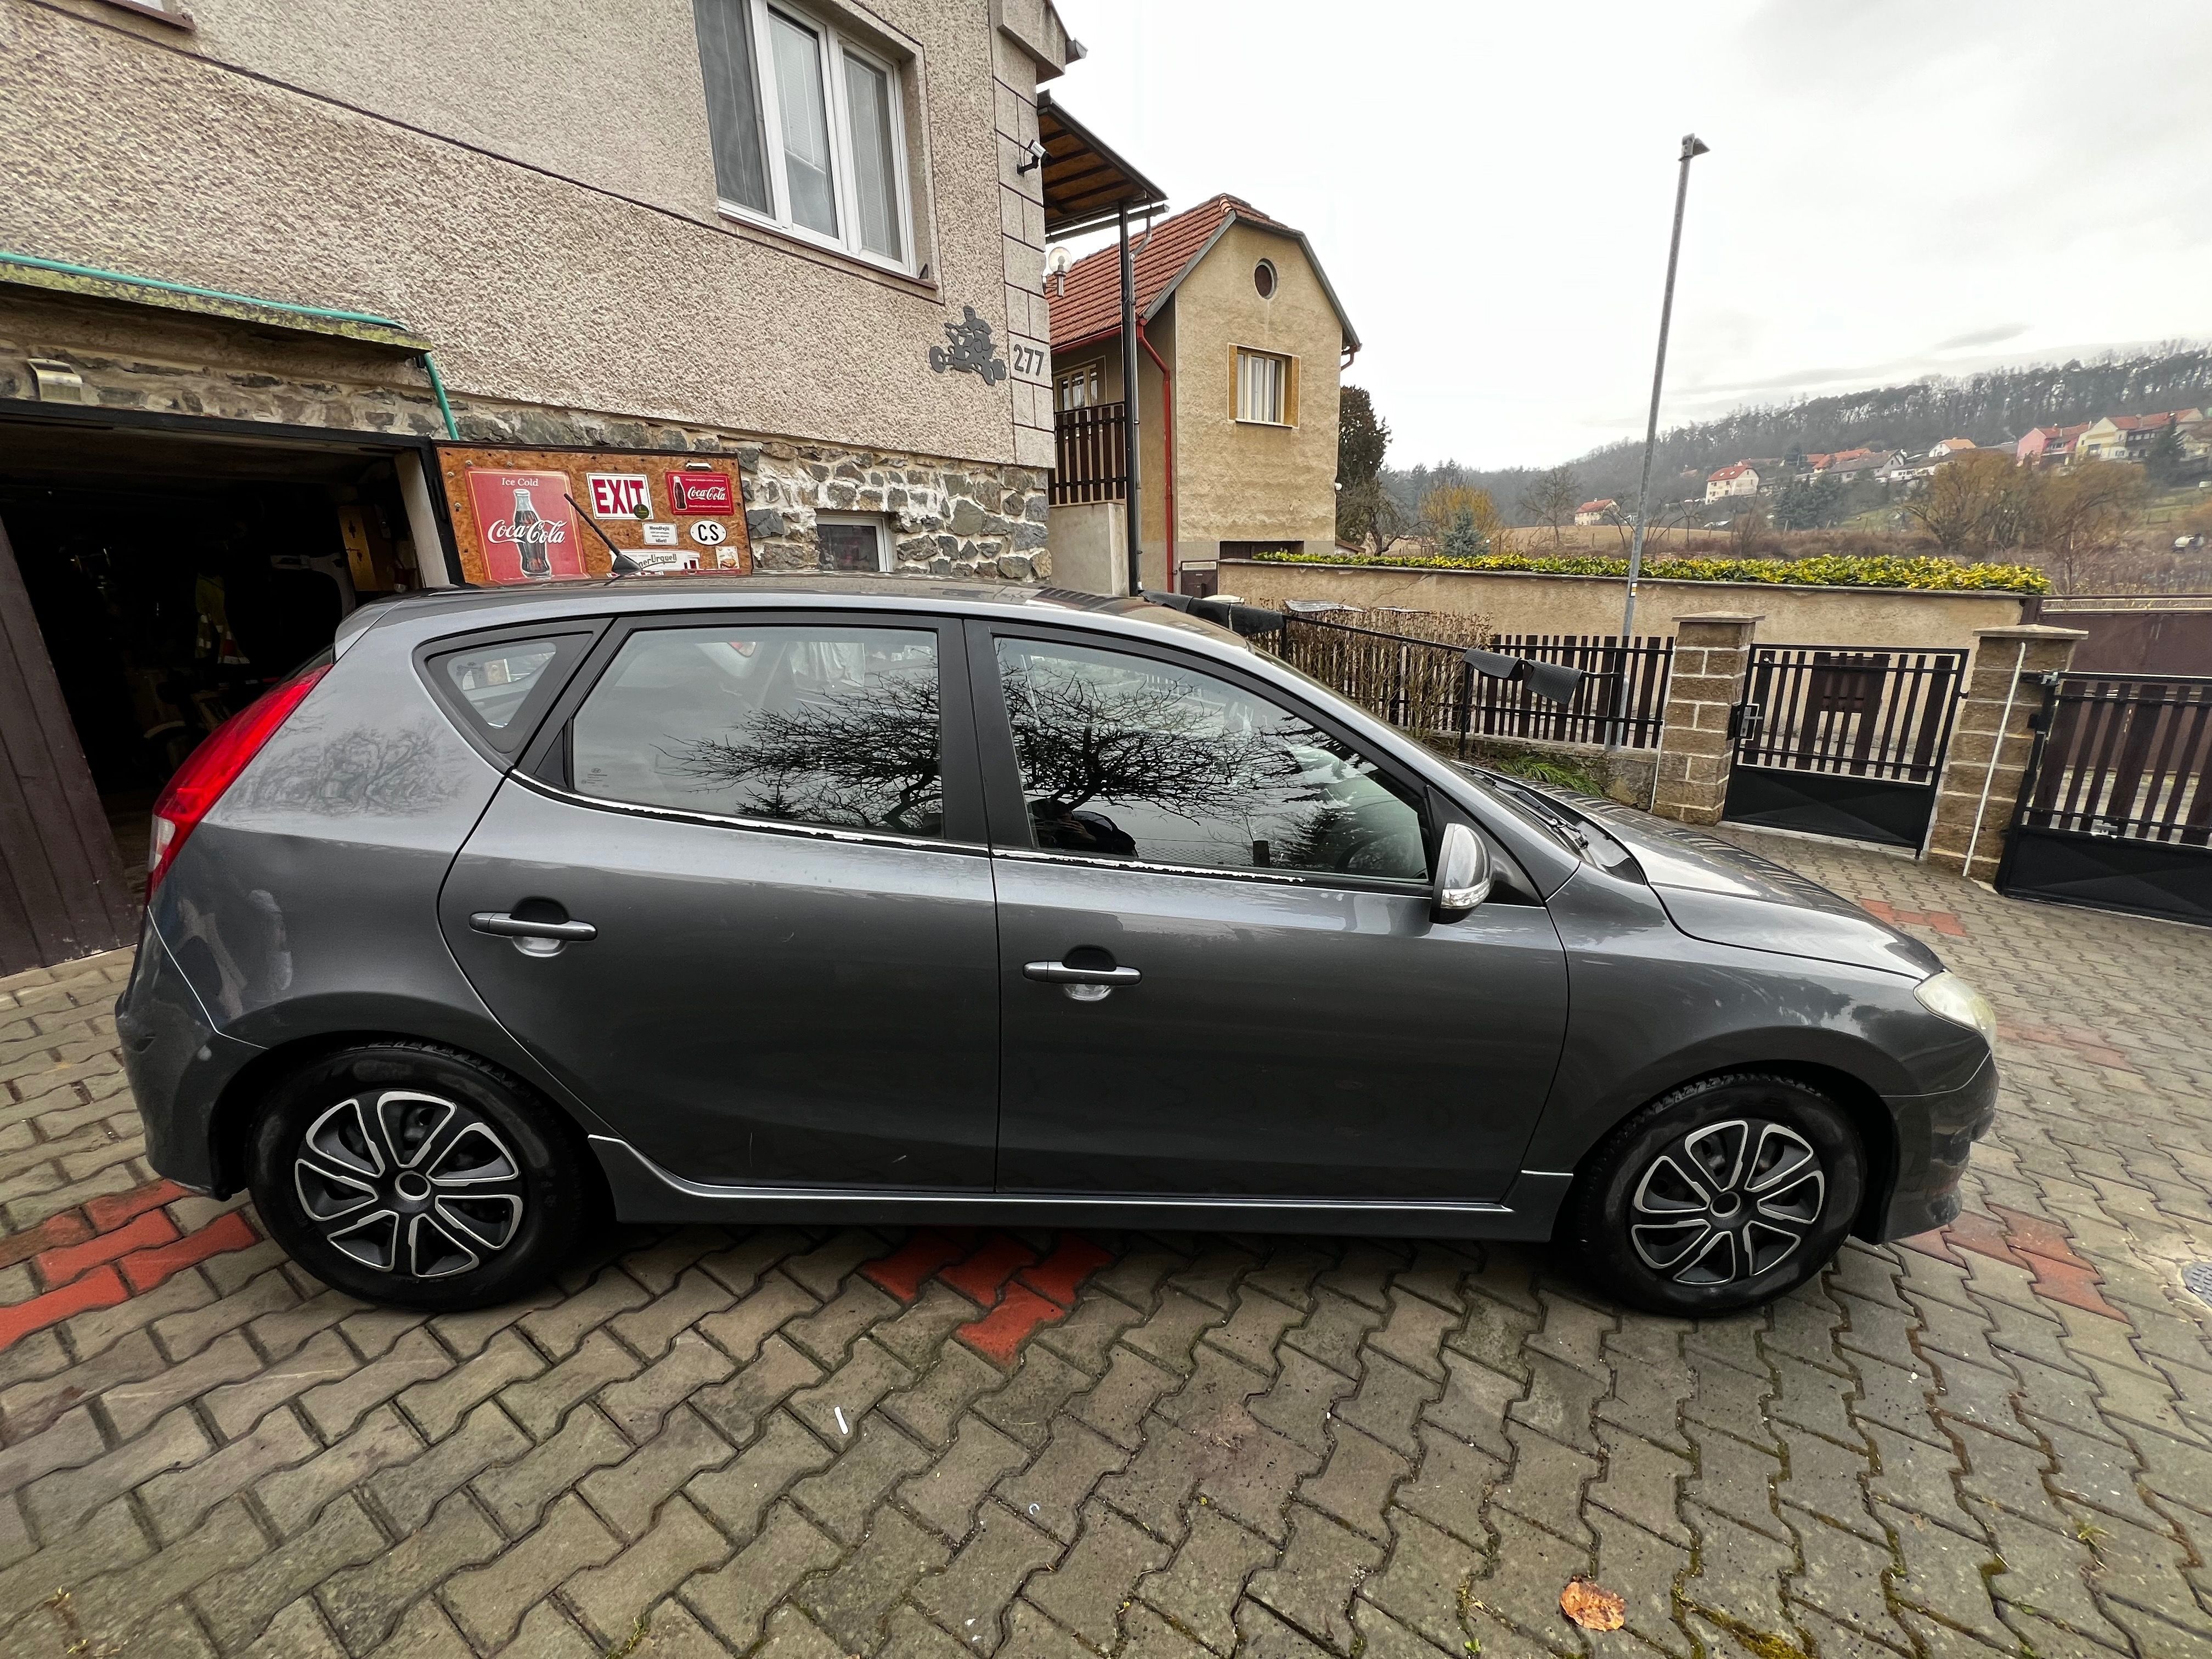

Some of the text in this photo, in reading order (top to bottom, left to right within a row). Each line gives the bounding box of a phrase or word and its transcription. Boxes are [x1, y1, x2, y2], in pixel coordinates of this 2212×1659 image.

[1014, 343, 1045, 376] 277
[501, 477, 539, 487] Ice Cold
[591, 478, 644, 514] EXIT
[687, 486, 726, 501] Coca-Cola
[487, 519, 567, 544] Coca-Cola
[697, 524, 719, 541] CS
